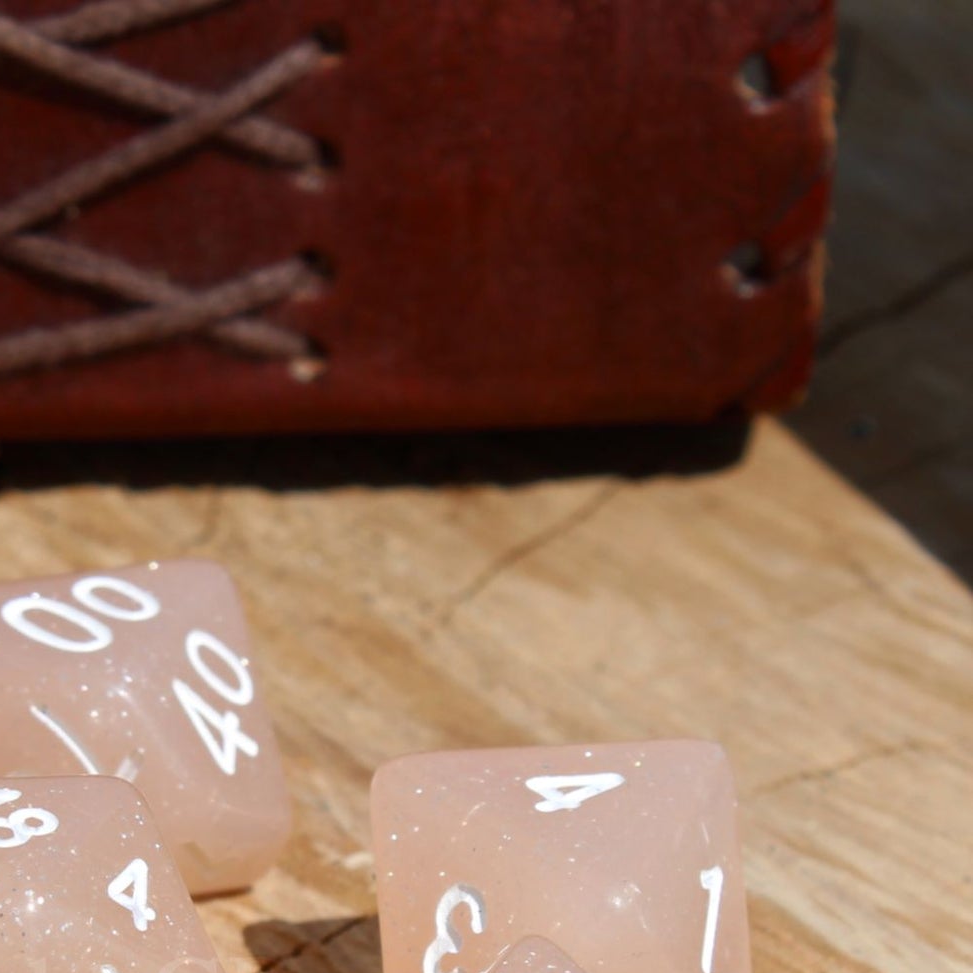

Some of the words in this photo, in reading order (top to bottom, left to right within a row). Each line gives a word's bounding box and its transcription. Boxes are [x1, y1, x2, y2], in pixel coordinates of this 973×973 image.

[2, 576, 160, 653] 00
[172, 629, 259, 775] 40
[526, 771, 625, 812] 4
[108, 858, 156, 932] 4
